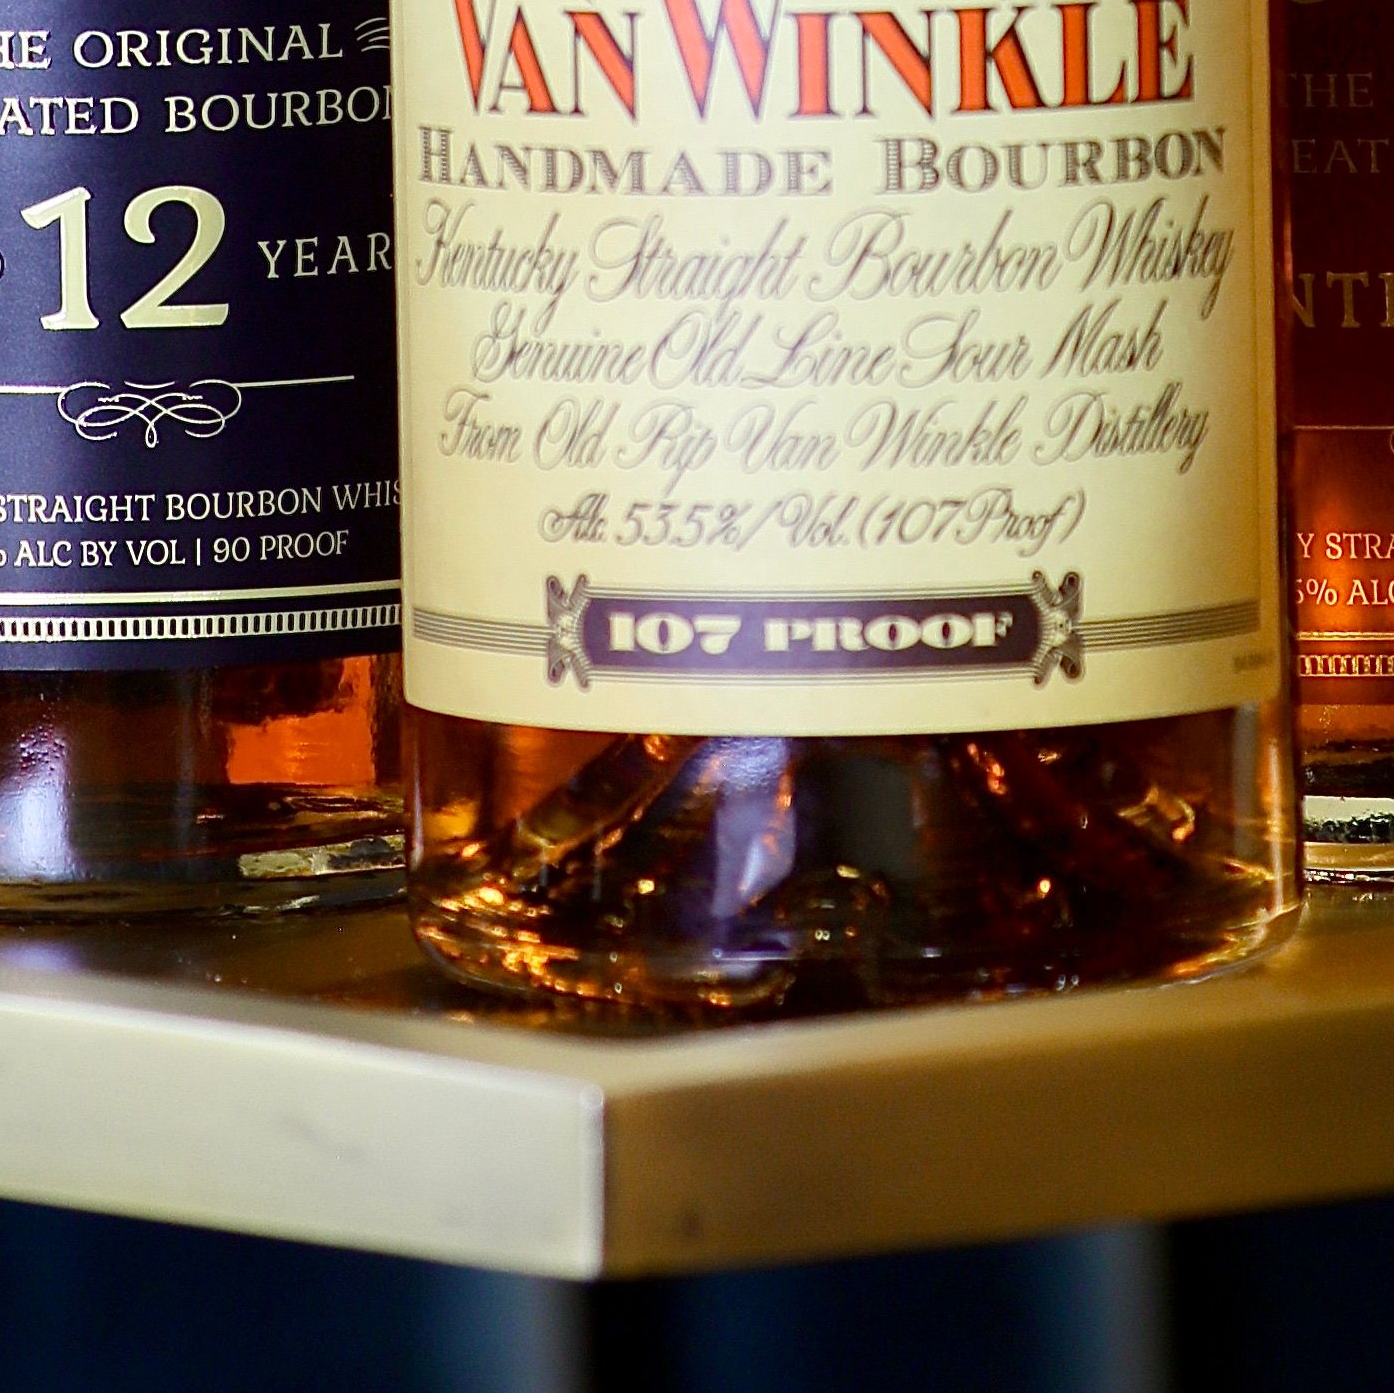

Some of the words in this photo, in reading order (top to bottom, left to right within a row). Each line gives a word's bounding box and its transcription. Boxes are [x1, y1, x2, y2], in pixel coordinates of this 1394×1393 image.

[73, 22, 343, 68] ORIGINAL
[20, 185, 230, 330] 12
[416, 197, 581, 337] Kentucky
[585, 213, 807, 323] Straight
[809, 207, 1062, 303] Bourbon
[1066, 193, 1234, 320] Whiskey
[473, 300, 647, 384] Genuine
[649, 303, 762, 390] Old
[740, 309, 896, 388] Line
[1037, 295, 1165, 381] Mash
[440, 387, 522, 464] From
[534, 395, 621, 471] Old
[613, 397, 719, 499] Rip
[724, 397, 841, 475] Van
[845, 393, 1031, 473] Winkle
[1034, 379, 1209, 476] Distillery
[165, 487, 323, 522] BOURBON
[14, 539, 73, 567] ALC
[80, 541, 118, 567] BY
[126, 538, 186, 567] VOL
[213, 536, 252, 565] 90
[260, 529, 349, 560] PROOF
[609, 611, 741, 655] 107
[764, 611, 1013, 653] PROOF
